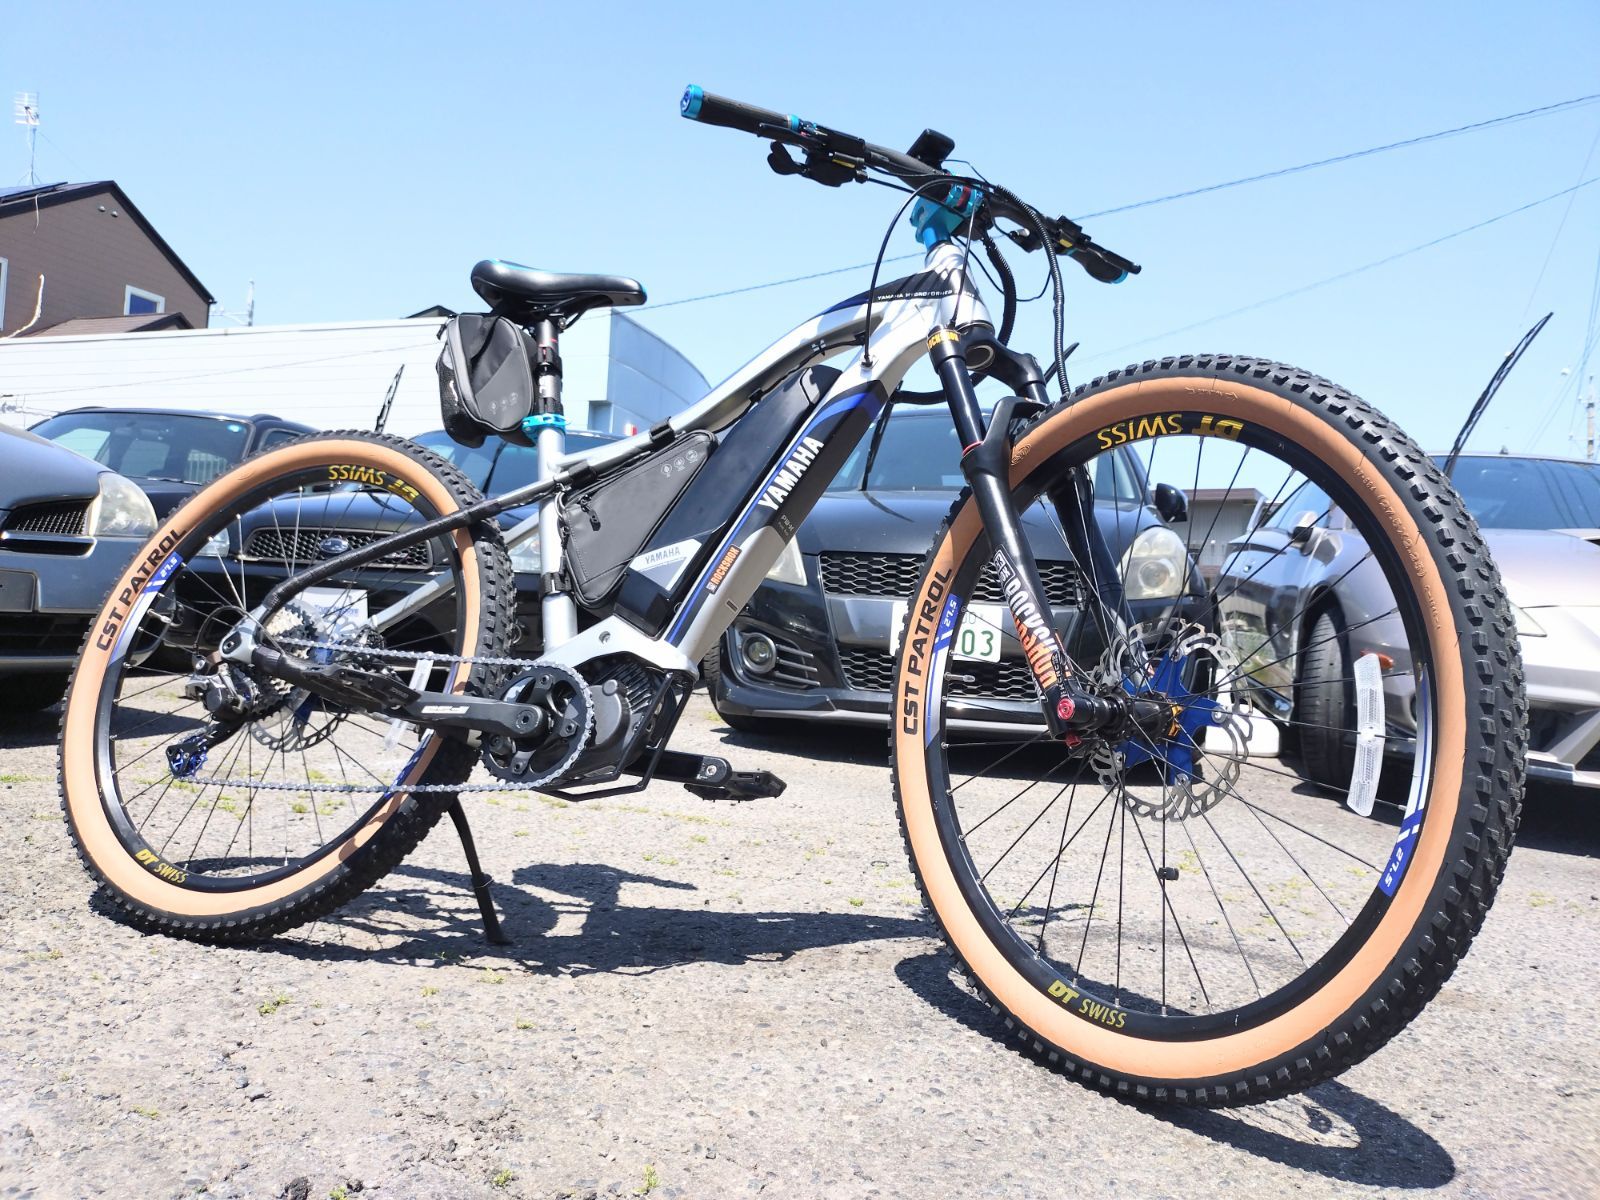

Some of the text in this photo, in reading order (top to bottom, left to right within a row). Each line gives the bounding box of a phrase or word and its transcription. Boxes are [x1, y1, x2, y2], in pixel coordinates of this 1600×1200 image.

[1096, 413, 1245, 450] DT SWISS
[328, 465, 420, 503] DT SWISS
[757, 436, 824, 511] YAMAHA
[160, 556, 178, 579] 27.5
[644, 547, 682, 566] YAMAHA
[711, 548, 741, 585] ROCKSHOX
[96, 526, 187, 652] CST PATROL
[943, 599, 958, 628] 27.5
[903, 568, 953, 736] CST PATROL
[135, 848, 188, 884] DT SWISS
[1384, 847, 1404, 888] 27.5
[1047, 978, 1128, 1029] DT SWISS
